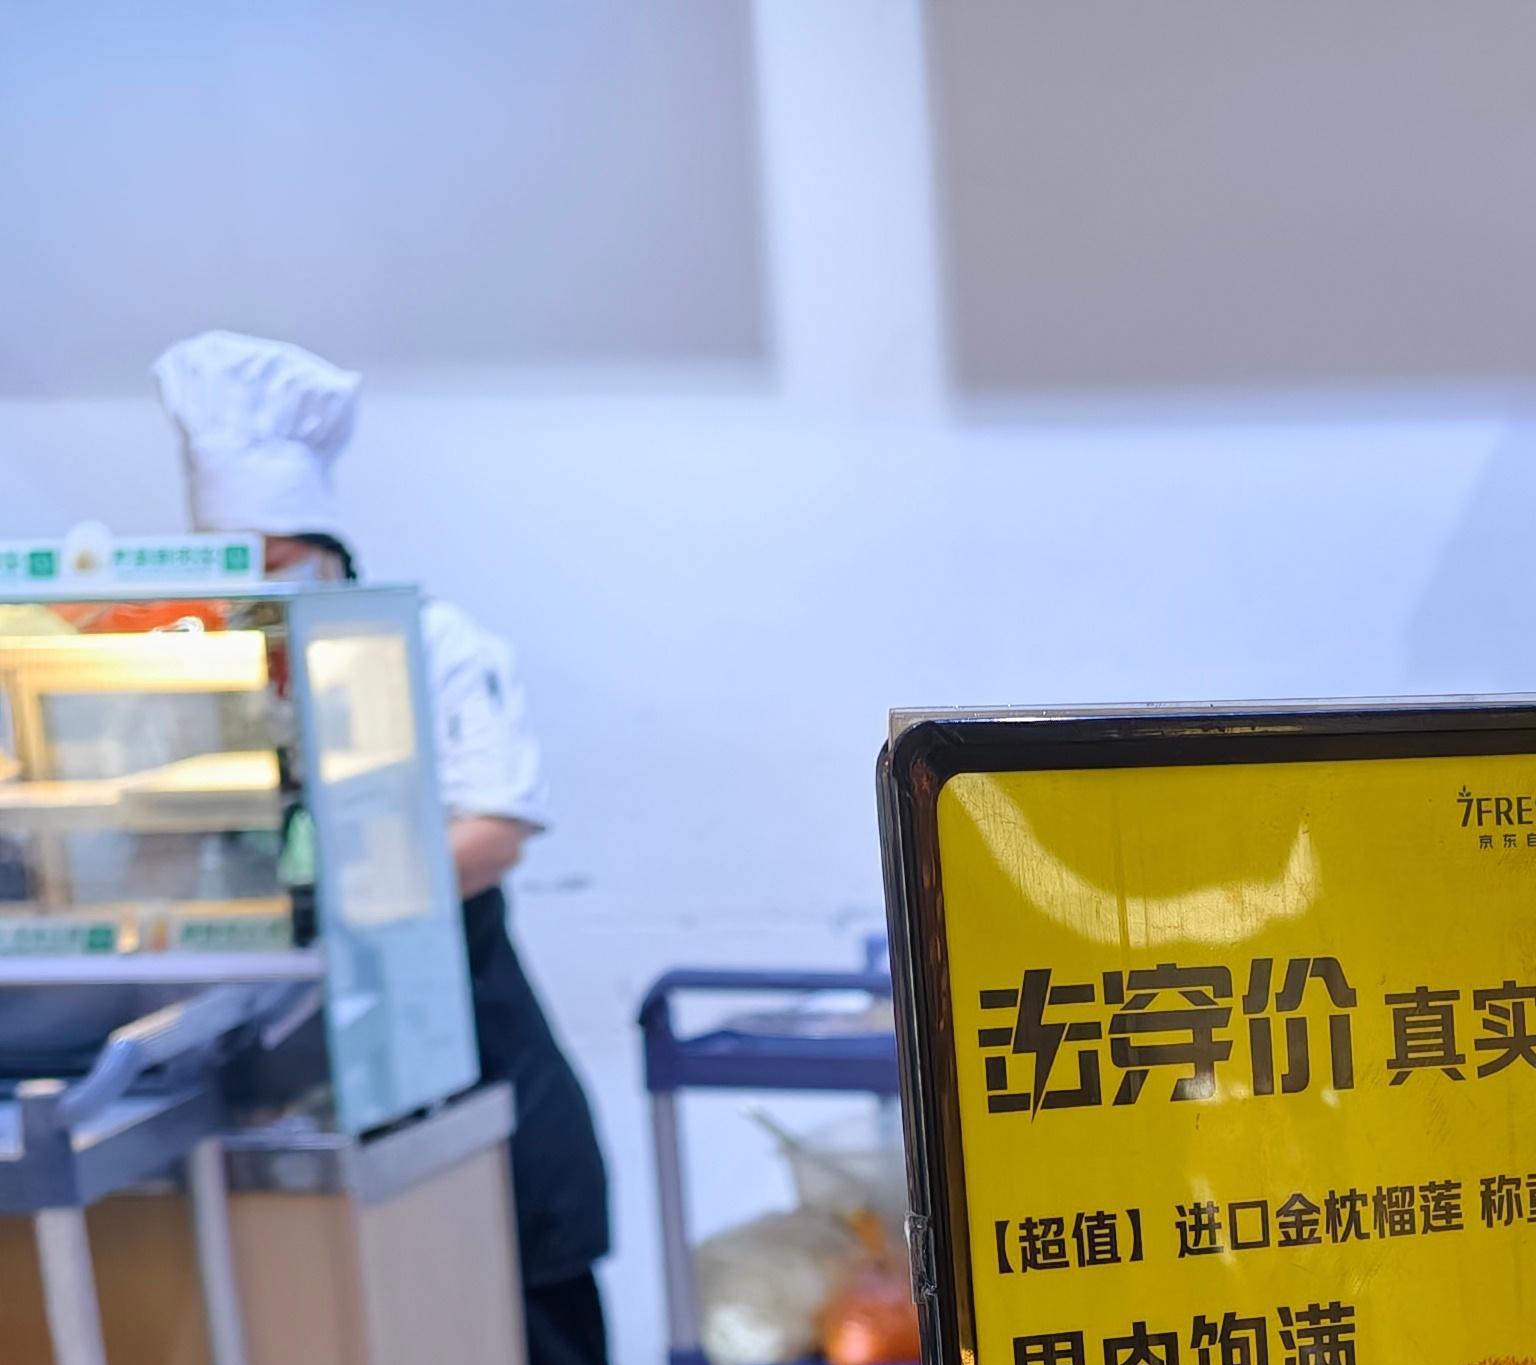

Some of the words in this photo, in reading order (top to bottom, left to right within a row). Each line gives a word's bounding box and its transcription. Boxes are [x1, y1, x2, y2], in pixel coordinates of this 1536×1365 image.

[978, 957, 1357, 1121] 击穿价
[1175, 1180, 1463, 1258] 进口金枕榴莲
